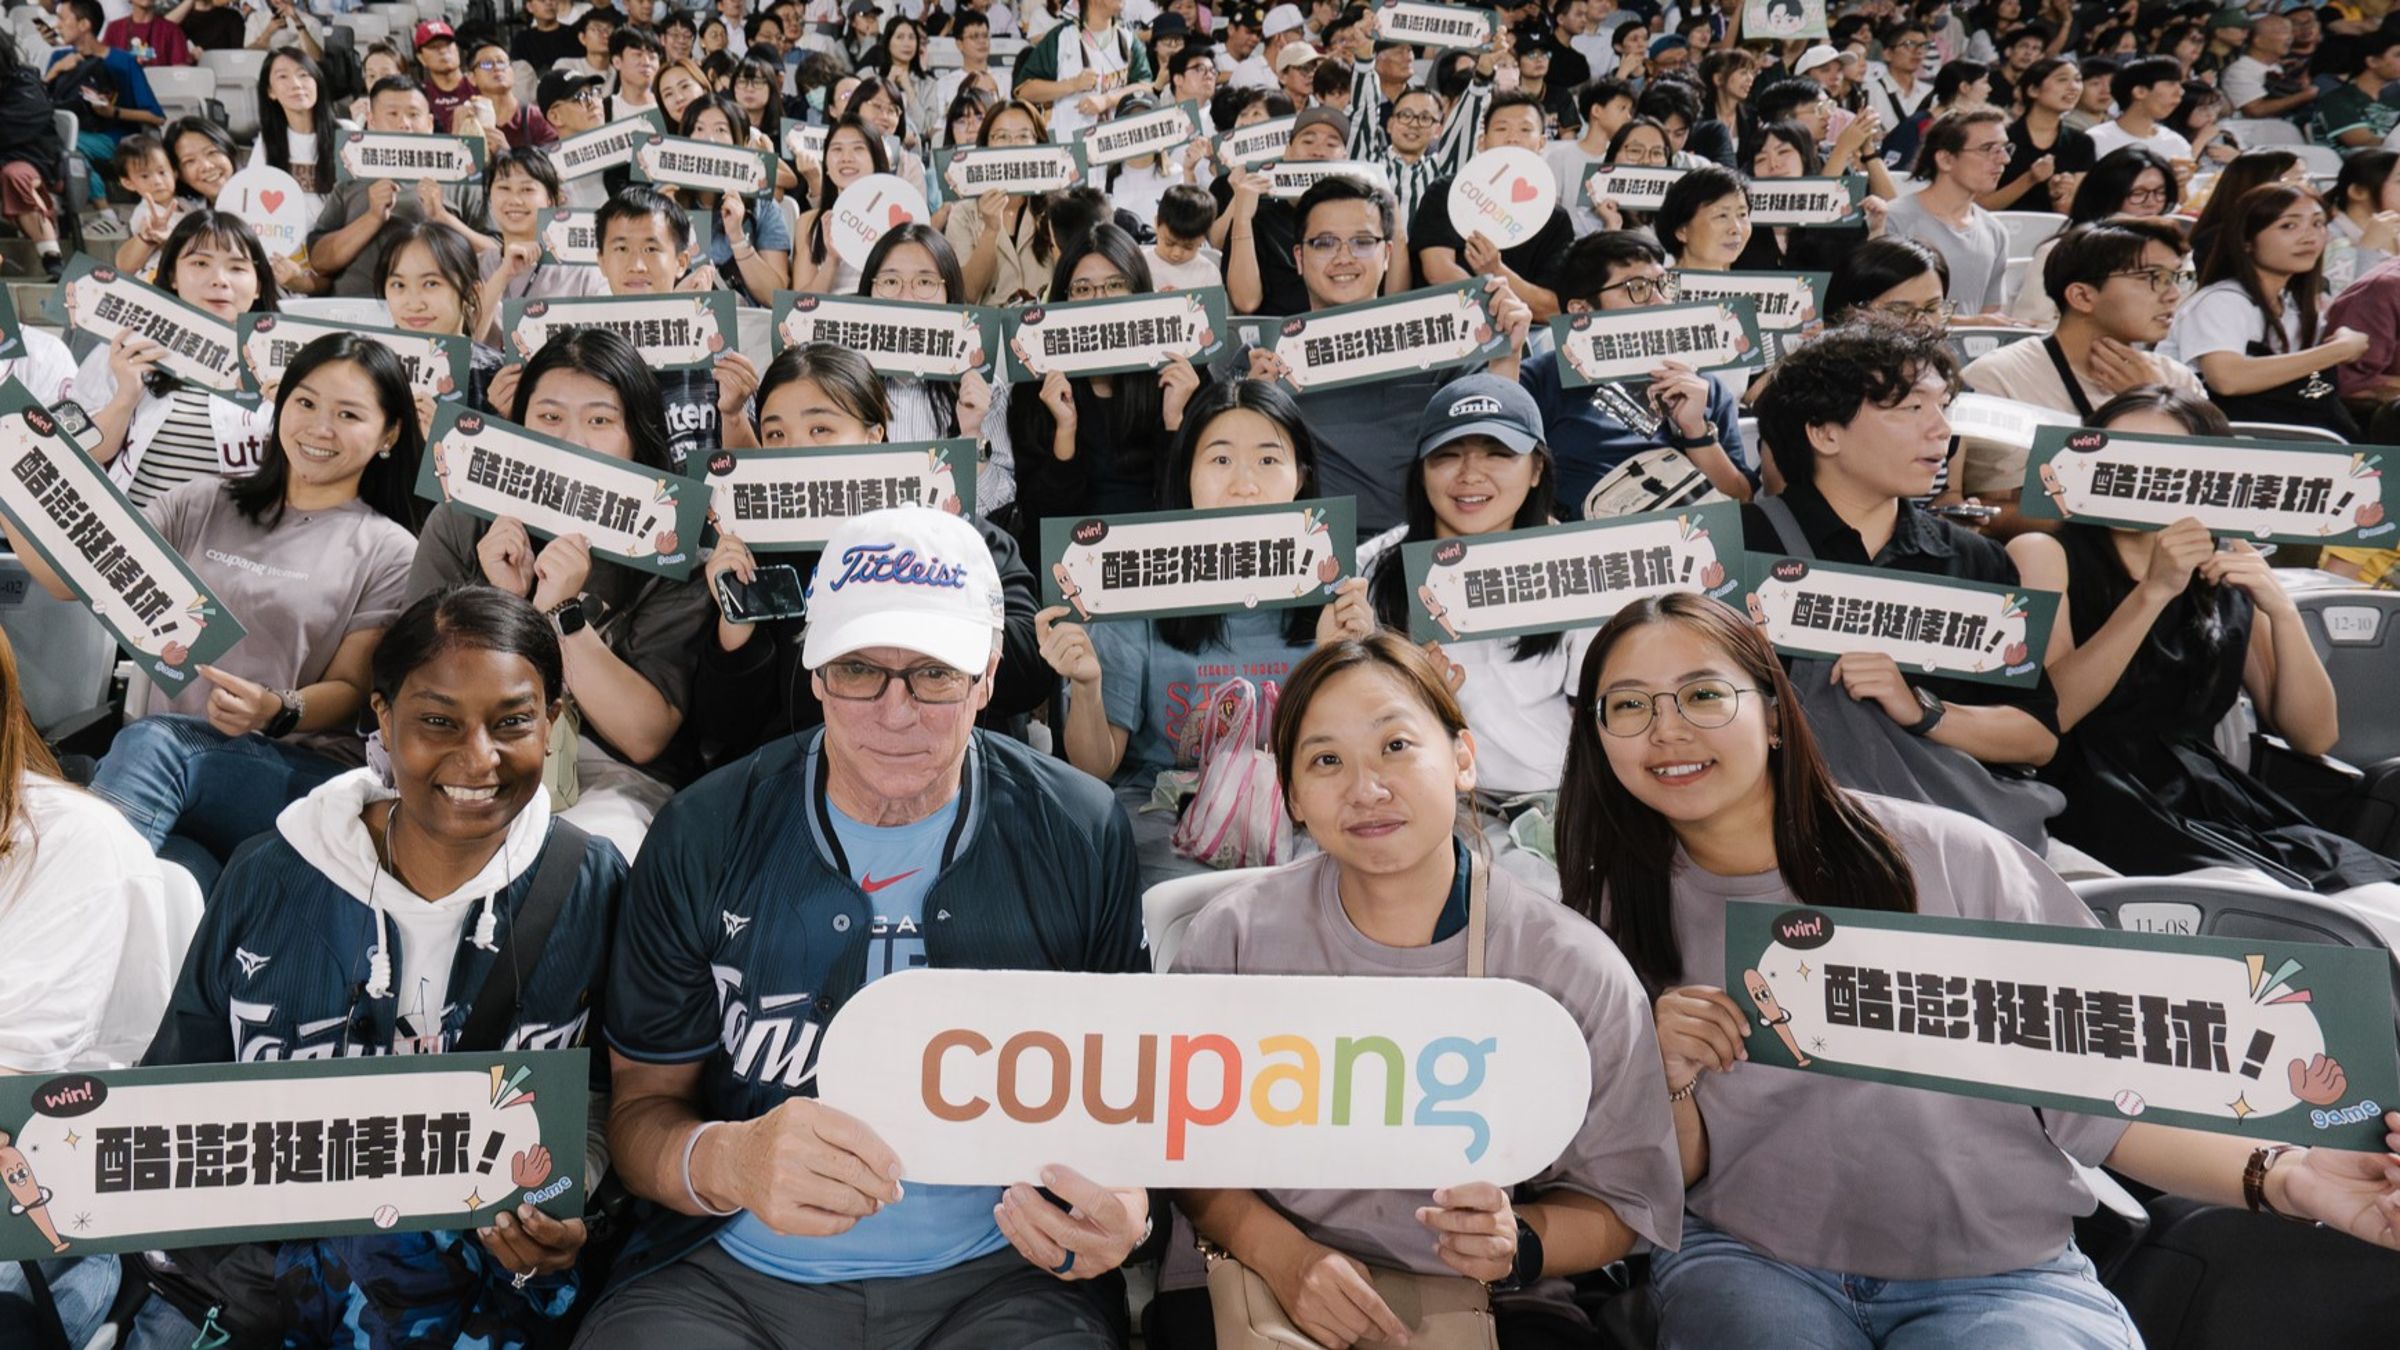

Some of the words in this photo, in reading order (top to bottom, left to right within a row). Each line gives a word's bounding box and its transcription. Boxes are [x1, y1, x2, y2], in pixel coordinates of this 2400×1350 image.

[564, 133, 633, 168] 酷澎挺棒
[840, 209, 878, 243] coup
[1460, 180, 1524, 240] coupang
[250, 222, 294, 243] pang
[812, 319, 968, 359] 酷澎挺棒球!
[1042, 316, 1195, 356] 酷澎挺棒球!
[1304, 313, 1469, 367] 酷澎挺棒球!
[1592, 324, 1729, 361] 酷澎挺棒球!
[27, 410, 53, 434] win!
[1448, 397, 1502, 417] emis
[2072, 435, 2101, 448] win!
[467, 446, 657, 539] 酷澎挺棒球!
[2090, 462, 2354, 517] 酷澎挺棒球!
[11, 445, 178, 637] 酷澎挺棒球!
[1076, 523, 1103, 539] win!
[205, 548, 267, 575] coupang
[830, 542, 967, 592] Titleist
[1102, 537, 1314, 590] 酷澎挺棒球!
[1437, 544, 1462, 560] win!
[1777, 563, 1803, 576] win!
[1464, 546, 1694, 608] 酷澎挺棒球!
[1791, 592, 2004, 654] 酷澎挺棒球!
[2334, 617, 2372, 631] 12-10
[1782, 917, 1822, 939] win!
[1824, 962, 2275, 1080] 酷澎挺棒球!
[44, 1081, 94, 1109] win!
[920, 1028, 1497, 1165] coupang
[2310, 1100, 2381, 1129] game
[95, 1111, 506, 1194] 酷澎挺棒球!
